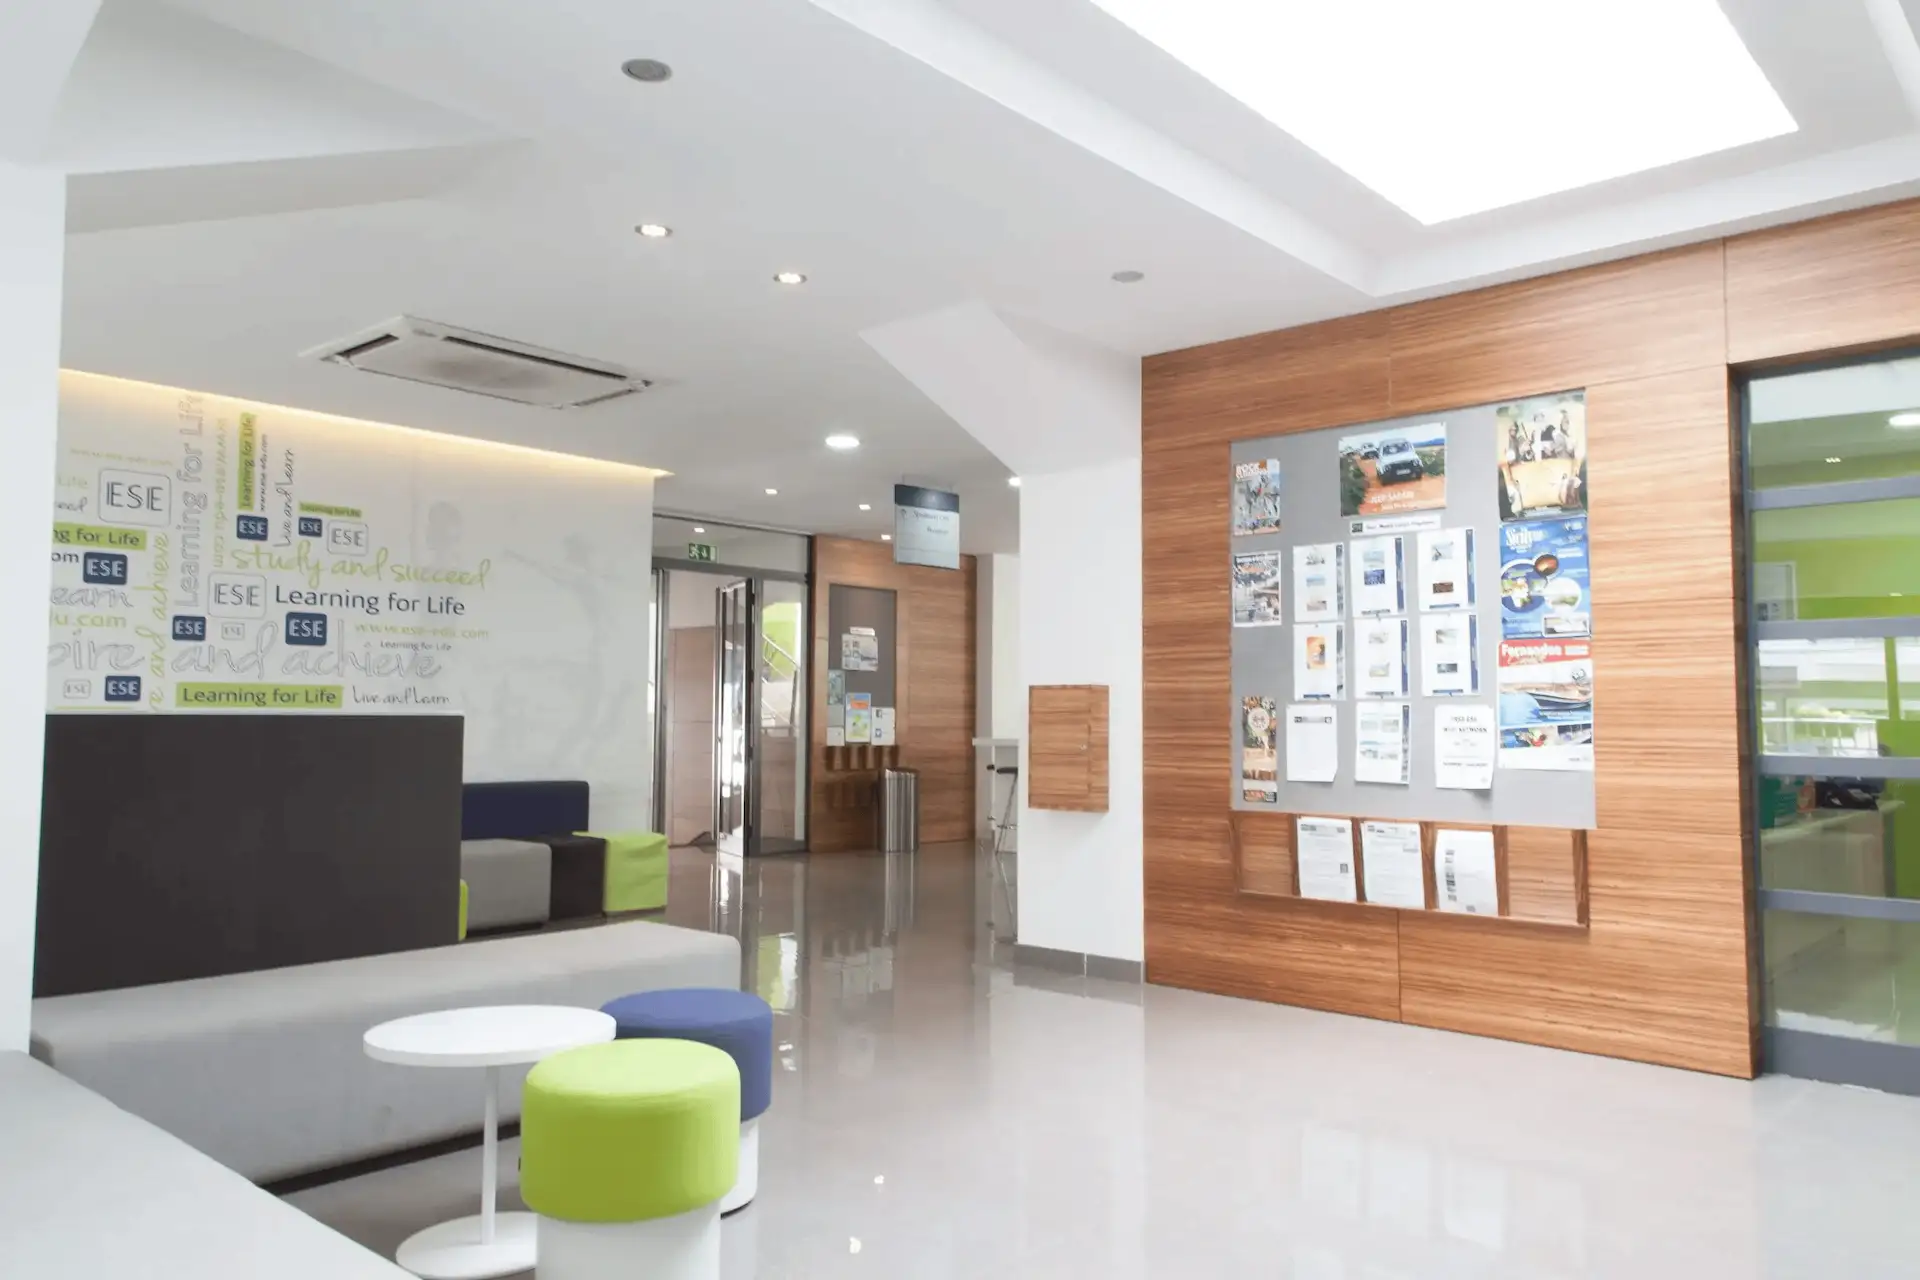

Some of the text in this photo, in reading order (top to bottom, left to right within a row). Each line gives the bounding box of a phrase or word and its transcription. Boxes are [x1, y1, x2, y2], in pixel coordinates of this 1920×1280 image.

[176, 442, 203, 484] for
[241, 459, 255, 508] Learning
[106, 481, 164, 512] ESE
[239, 519, 267, 535] ESE
[300, 520, 322, 533] ESE
[76, 527, 101, 544] for
[108, 531, 140, 547] Life
[331, 528, 366, 547] ESE
[175, 490, 208, 608] Learning
[85, 558, 125, 578] ESE
[330, 546, 389, 582] and
[389, 558, 491, 590] succeed
[213, 582, 261, 607] ESE
[274, 584, 466, 616] Learning for Life
[50, 610, 127, 629] u.com
[173, 619, 205, 635] ESE
[287, 618, 325, 638] ESE
[170, 620, 279, 680] and
[281, 618, 442, 679] achieve
[106, 680, 140, 696] ESE
[182, 687, 337, 708] Learning for Life
